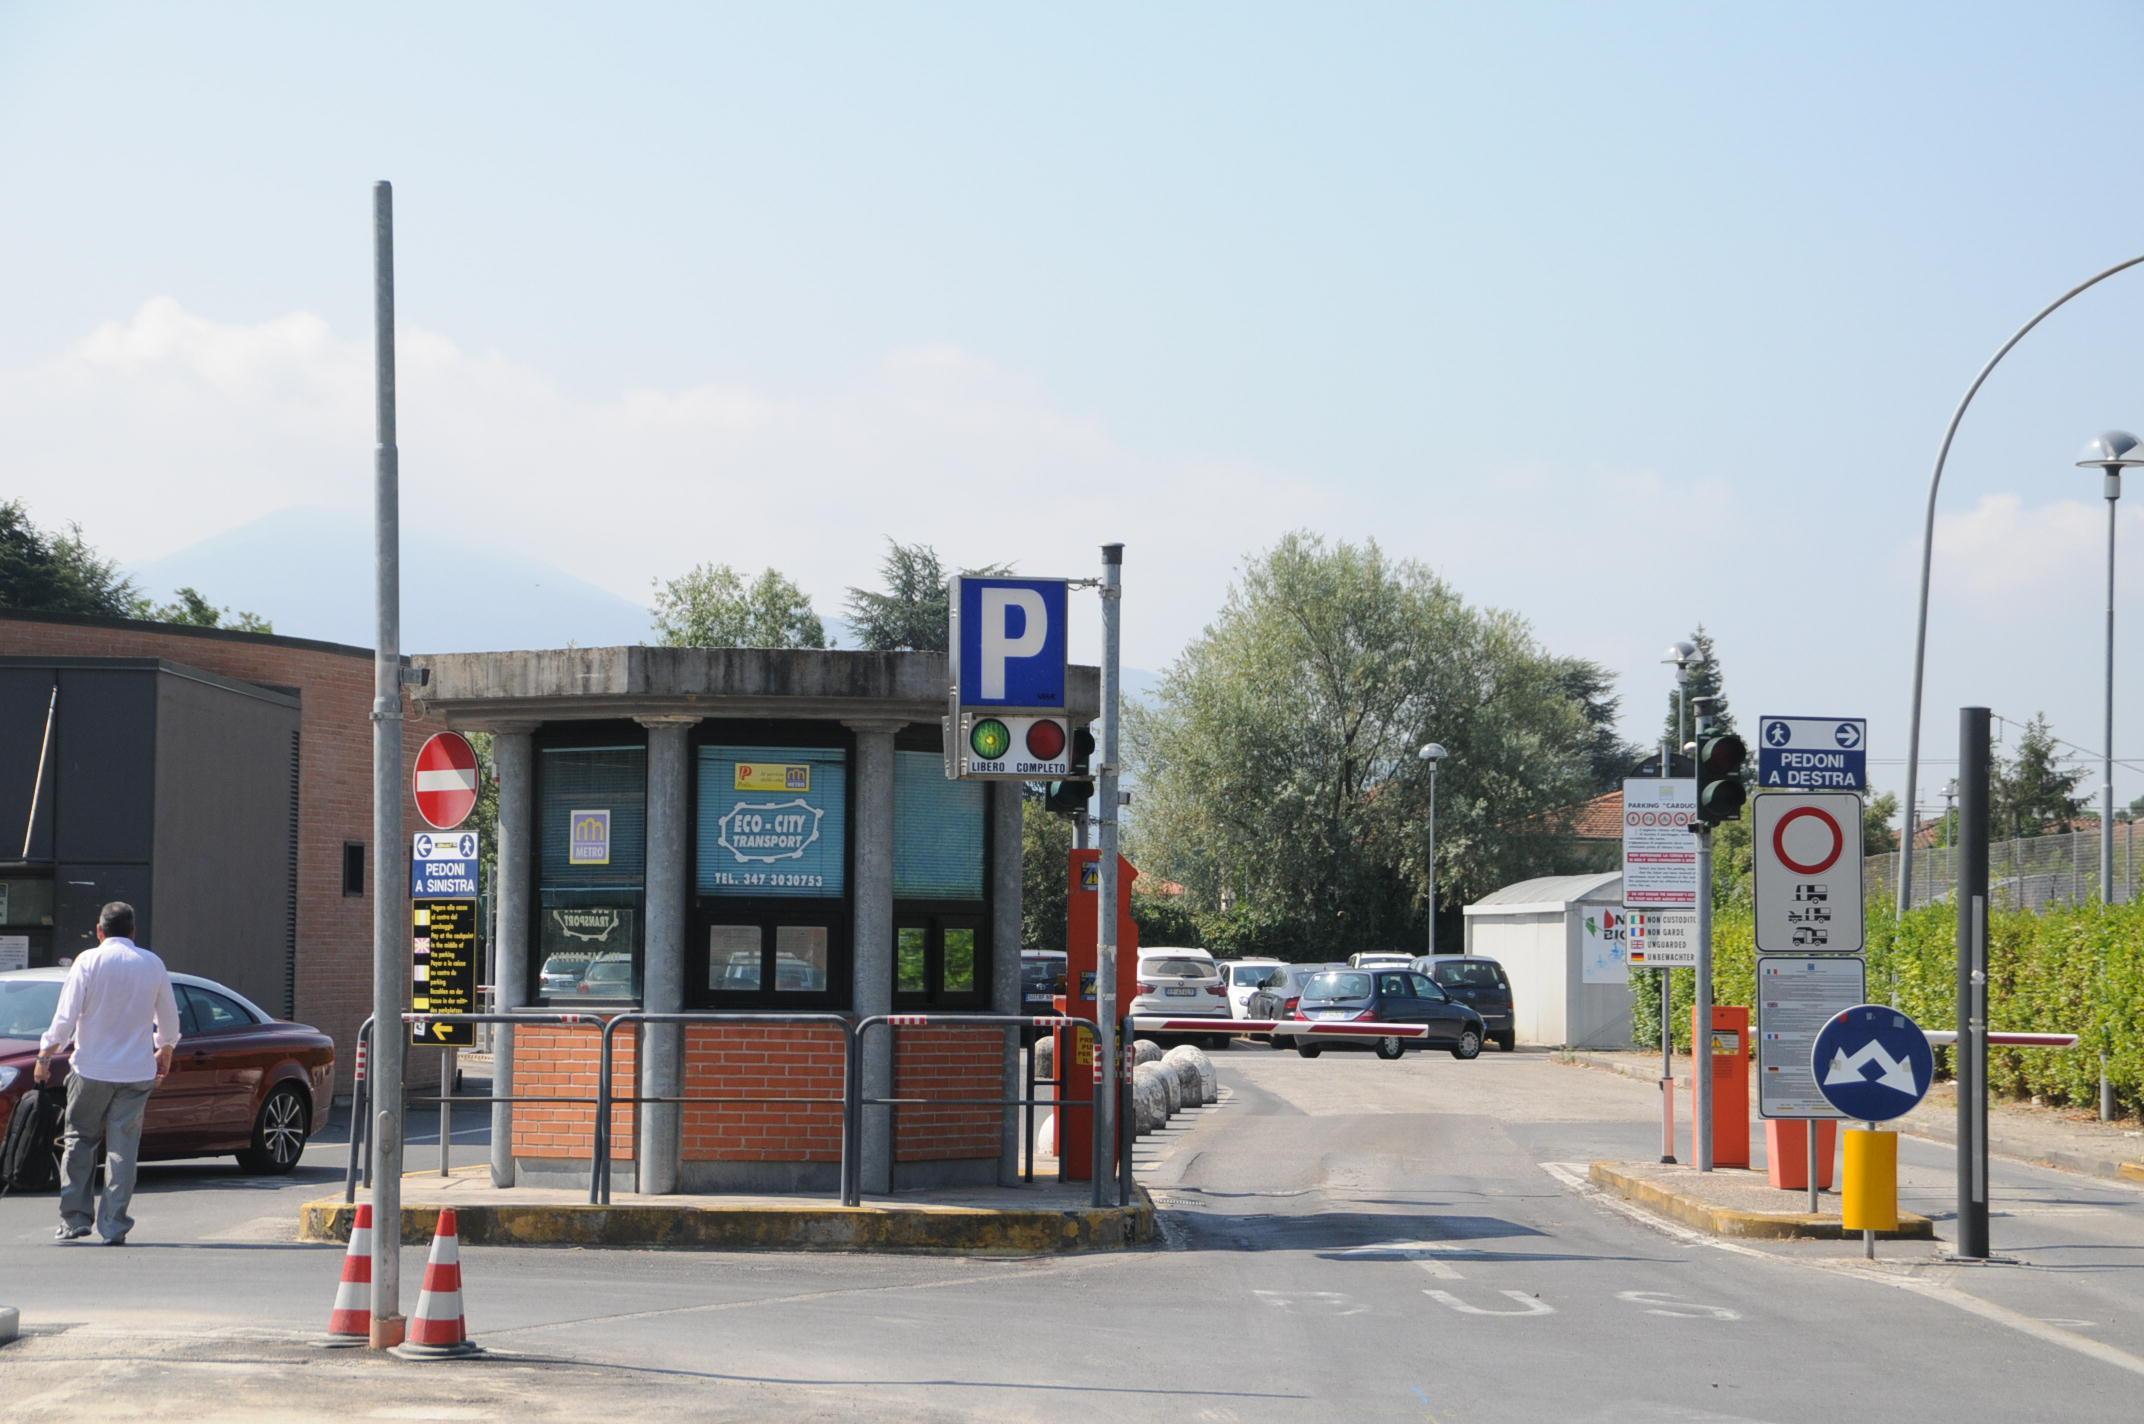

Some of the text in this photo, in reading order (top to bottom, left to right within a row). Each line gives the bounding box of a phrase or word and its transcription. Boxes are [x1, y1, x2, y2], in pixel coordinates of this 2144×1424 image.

[981, 587, 1048, 700] P
[1781, 752, 1844, 768] PEDONI
[972, 762, 1066, 774] LIBERO COMPLETO
[1768, 770, 1856, 786] A DESTRA
[734, 814, 762, 833] ECO
[774, 814, 806, 833] CITY
[732, 836, 802, 848] TRANSPORT
[575, 847, 604, 857] METRO
[425, 862, 465, 876] PEDONI
[414, 878, 475, 892] A SINISTRA
[714, 872, 823, 887] TEL. 347 3030753
